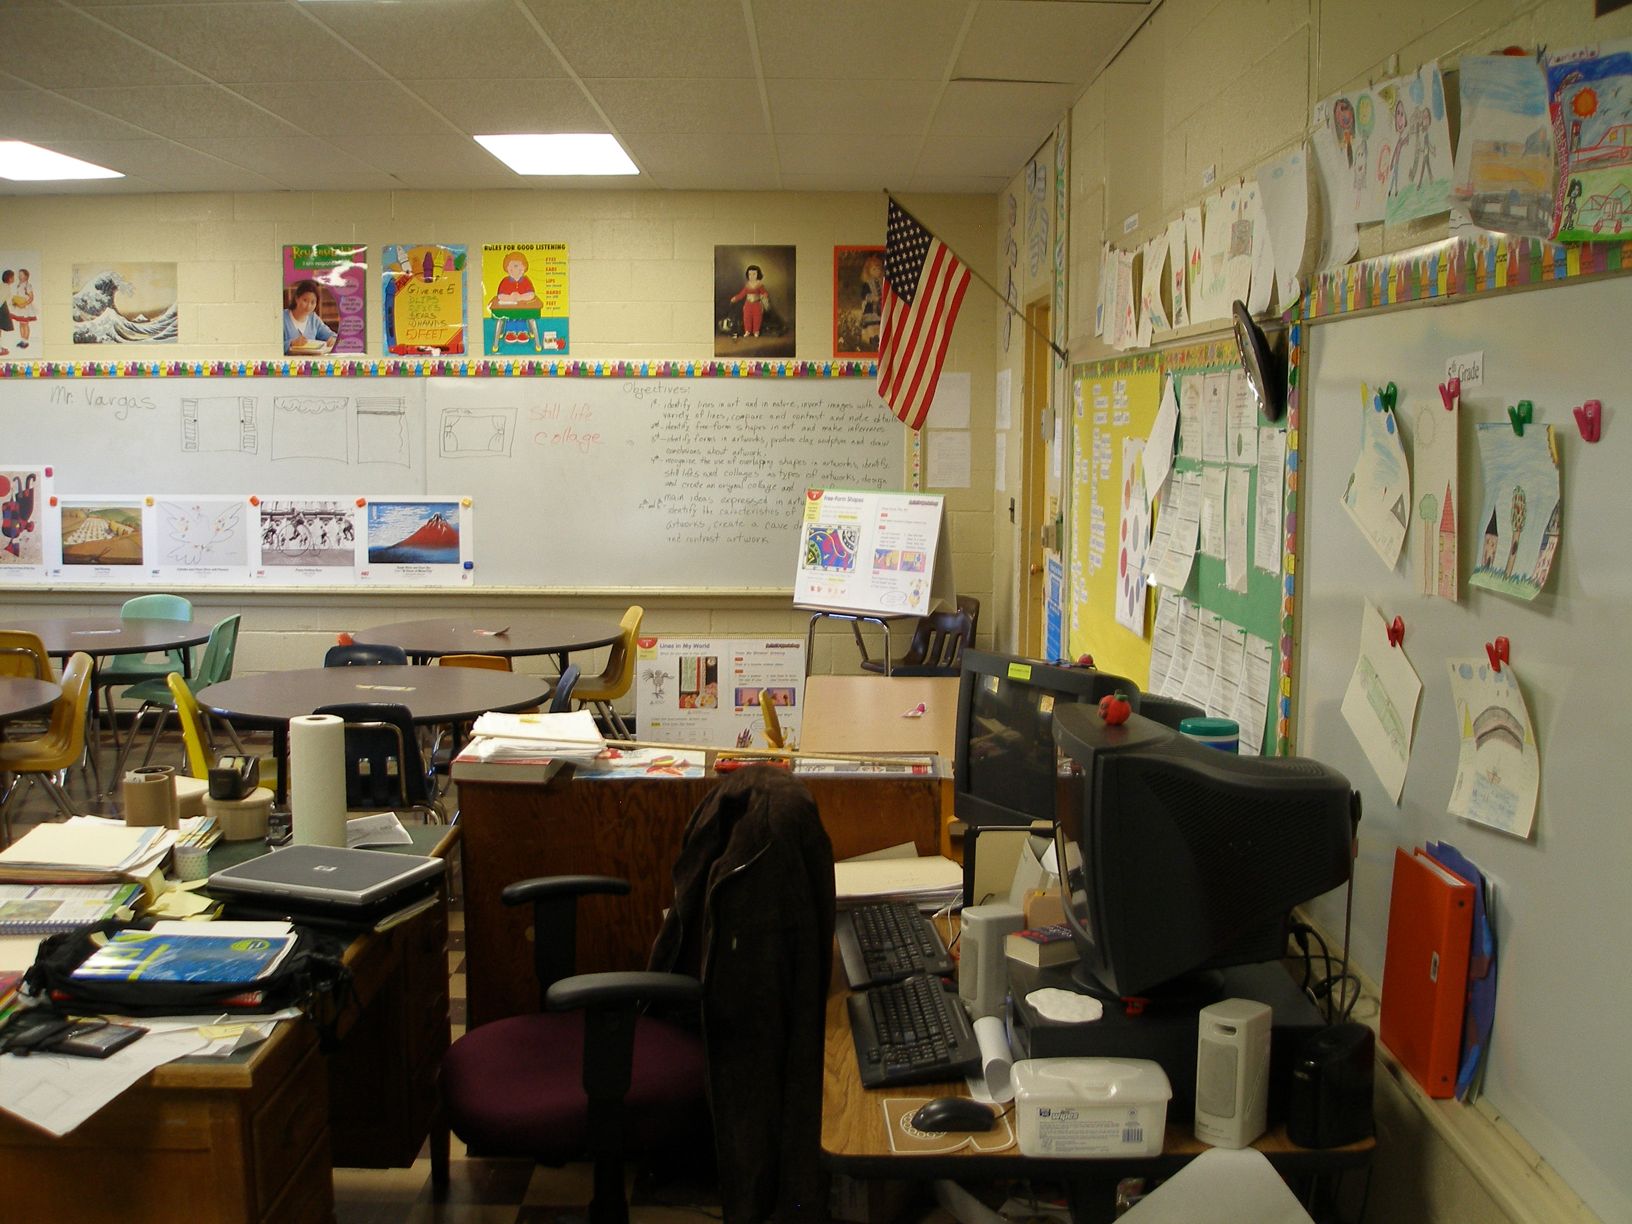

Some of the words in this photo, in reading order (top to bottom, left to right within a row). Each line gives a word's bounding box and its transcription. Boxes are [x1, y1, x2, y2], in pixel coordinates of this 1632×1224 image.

[407, 284, 429, 295] Give
[447, 283, 455, 294] 5
[623, 381, 690, 399] Objectives:
[50, 385, 74, 405] Mr.
[85, 386, 156, 420] Vargas
[664, 398, 690, 411] identify
[727, 396, 739, 407] art
[746, 398, 758, 408] and
[696, 409, 705, 419] of
[770, 411, 786, 420] and
[802, 424, 816, 432] and
[707, 446, 727, 455] about
[779, 458, 807, 471] shapes
[703, 469, 718, 477] and
[785, 508, 796, 517] of
